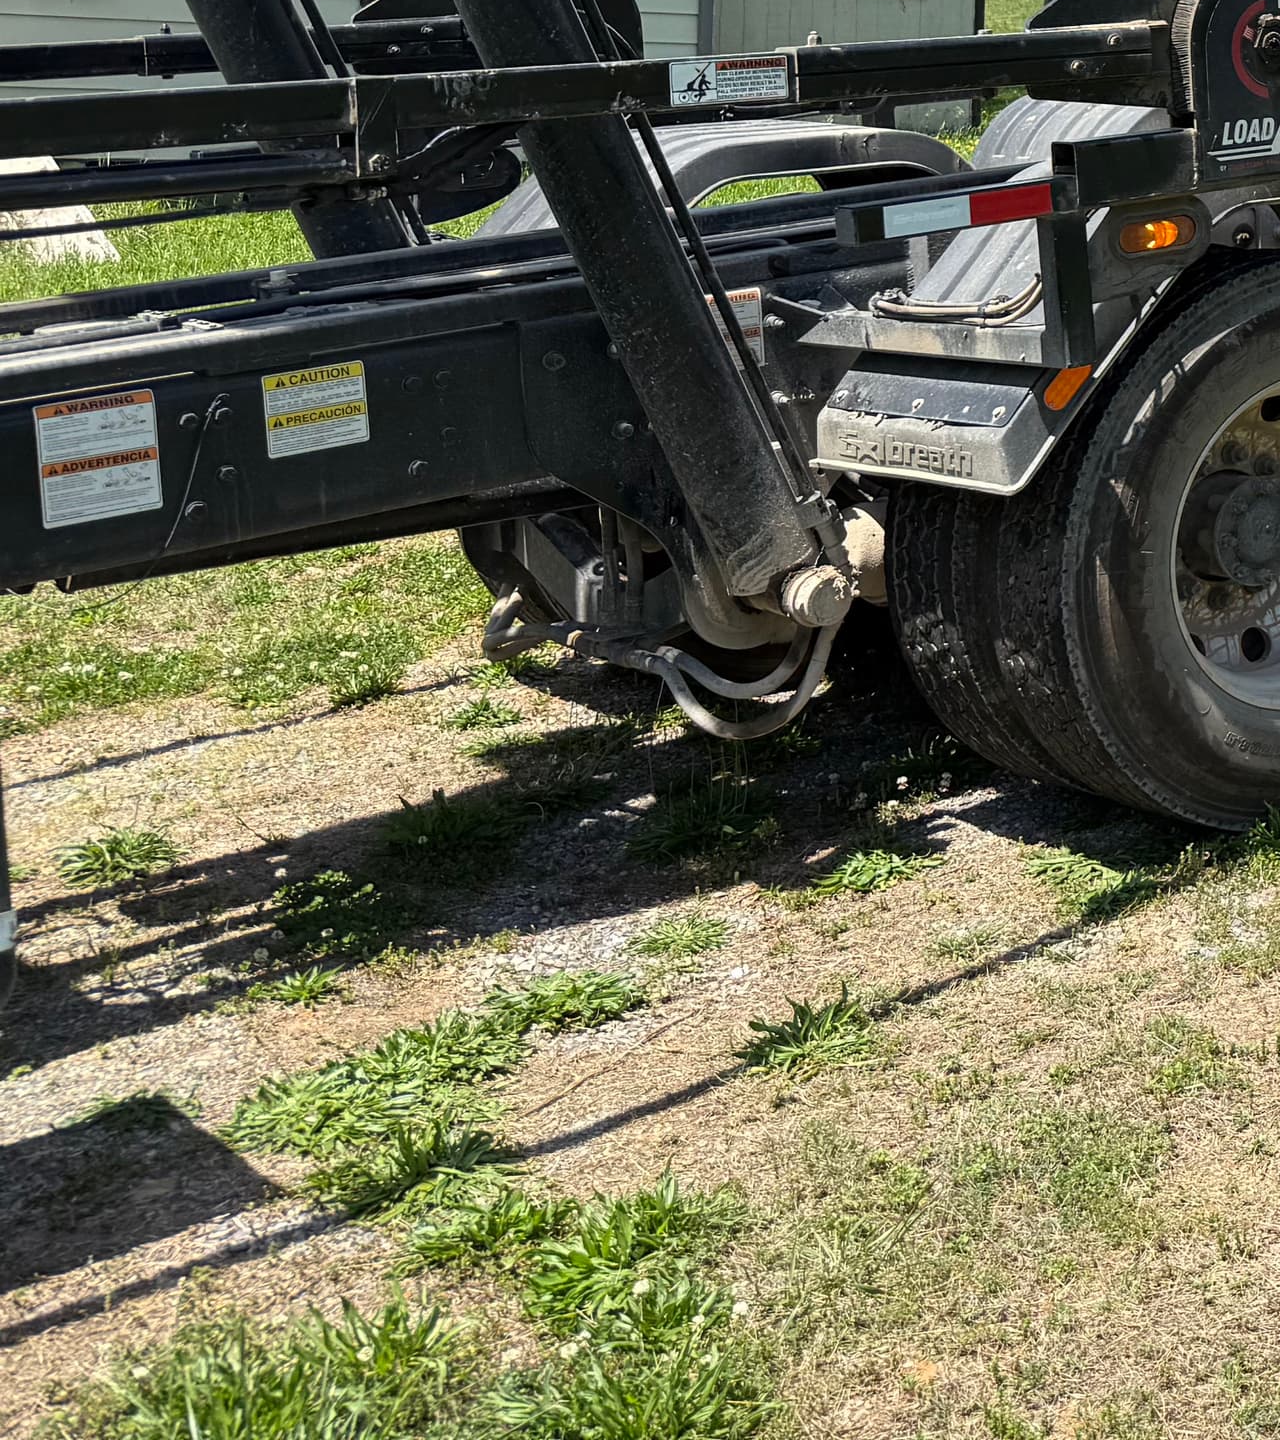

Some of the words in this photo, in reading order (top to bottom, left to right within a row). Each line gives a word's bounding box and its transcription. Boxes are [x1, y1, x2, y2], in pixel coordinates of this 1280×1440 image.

[1222, 117, 1275, 146] LOAD
[288, 366, 350, 385] CAUTION
[66, 395, 135, 414] WARNING
[286, 404, 361, 425] PRECAUCIÓN
[61, 450, 152, 474] ADVERTENCIA
